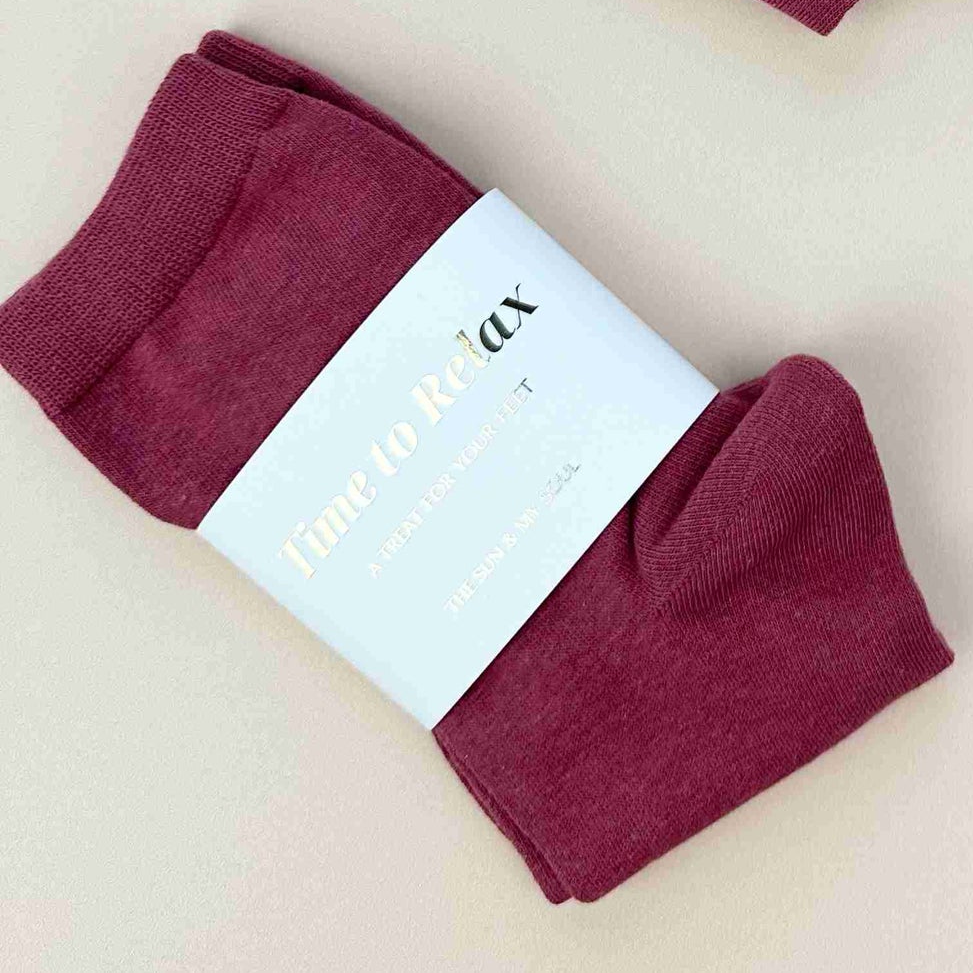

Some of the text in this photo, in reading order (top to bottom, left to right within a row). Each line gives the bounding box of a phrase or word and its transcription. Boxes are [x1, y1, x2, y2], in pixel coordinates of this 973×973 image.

[278, 283, 539, 579] Time to Relax
[368, 377, 533, 579] A TREAT FOR YOUR FEET
[504, 530, 518, 549] &
